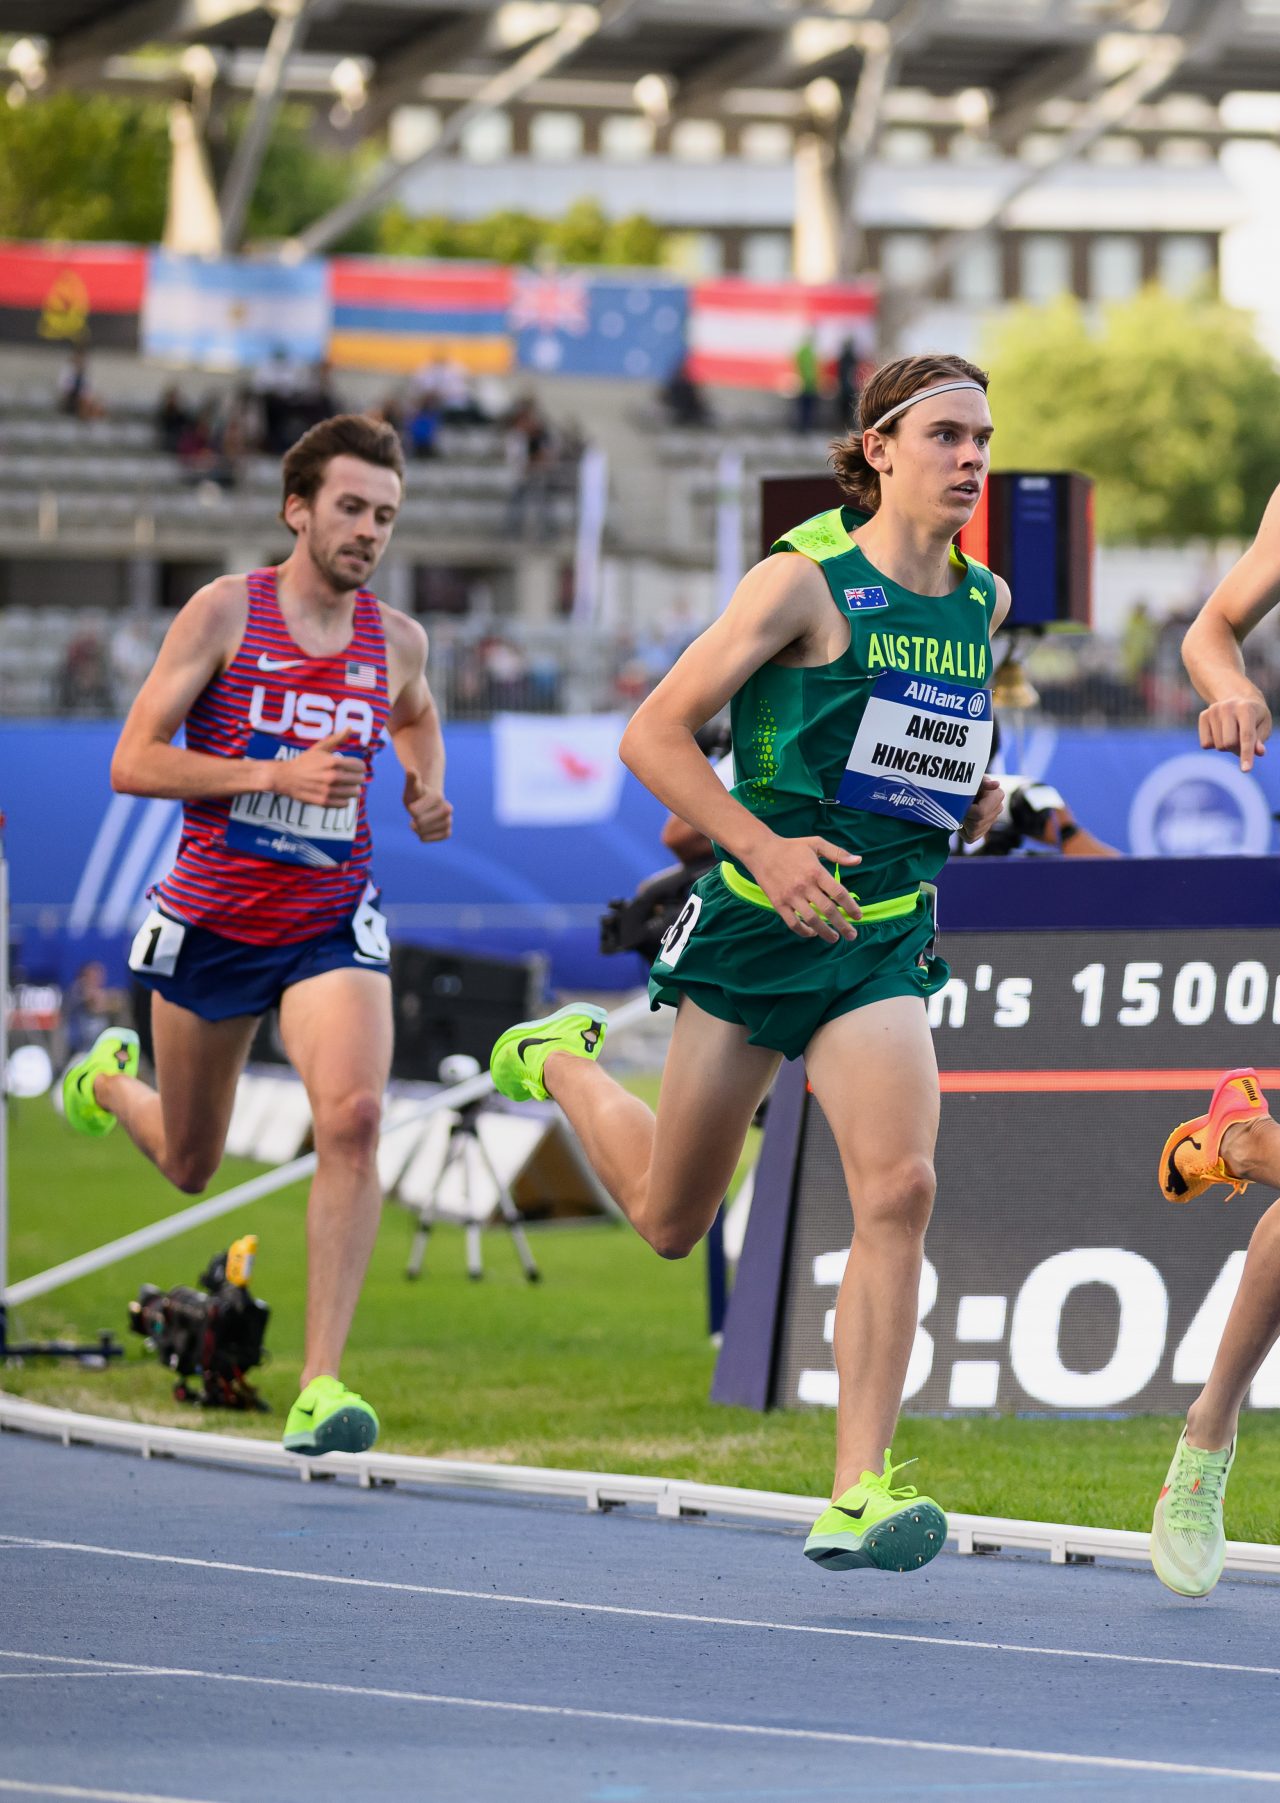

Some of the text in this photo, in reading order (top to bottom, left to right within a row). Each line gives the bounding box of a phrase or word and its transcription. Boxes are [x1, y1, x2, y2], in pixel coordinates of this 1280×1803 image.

[867, 633, 985, 679] AUSTRALIA
[249, 685, 373, 746] USA
[904, 681, 965, 710] Allianz
[905, 715, 969, 748] ANGUS
[871, 742, 975, 784] HINCKSMAN
[143, 926, 162, 966] 1
